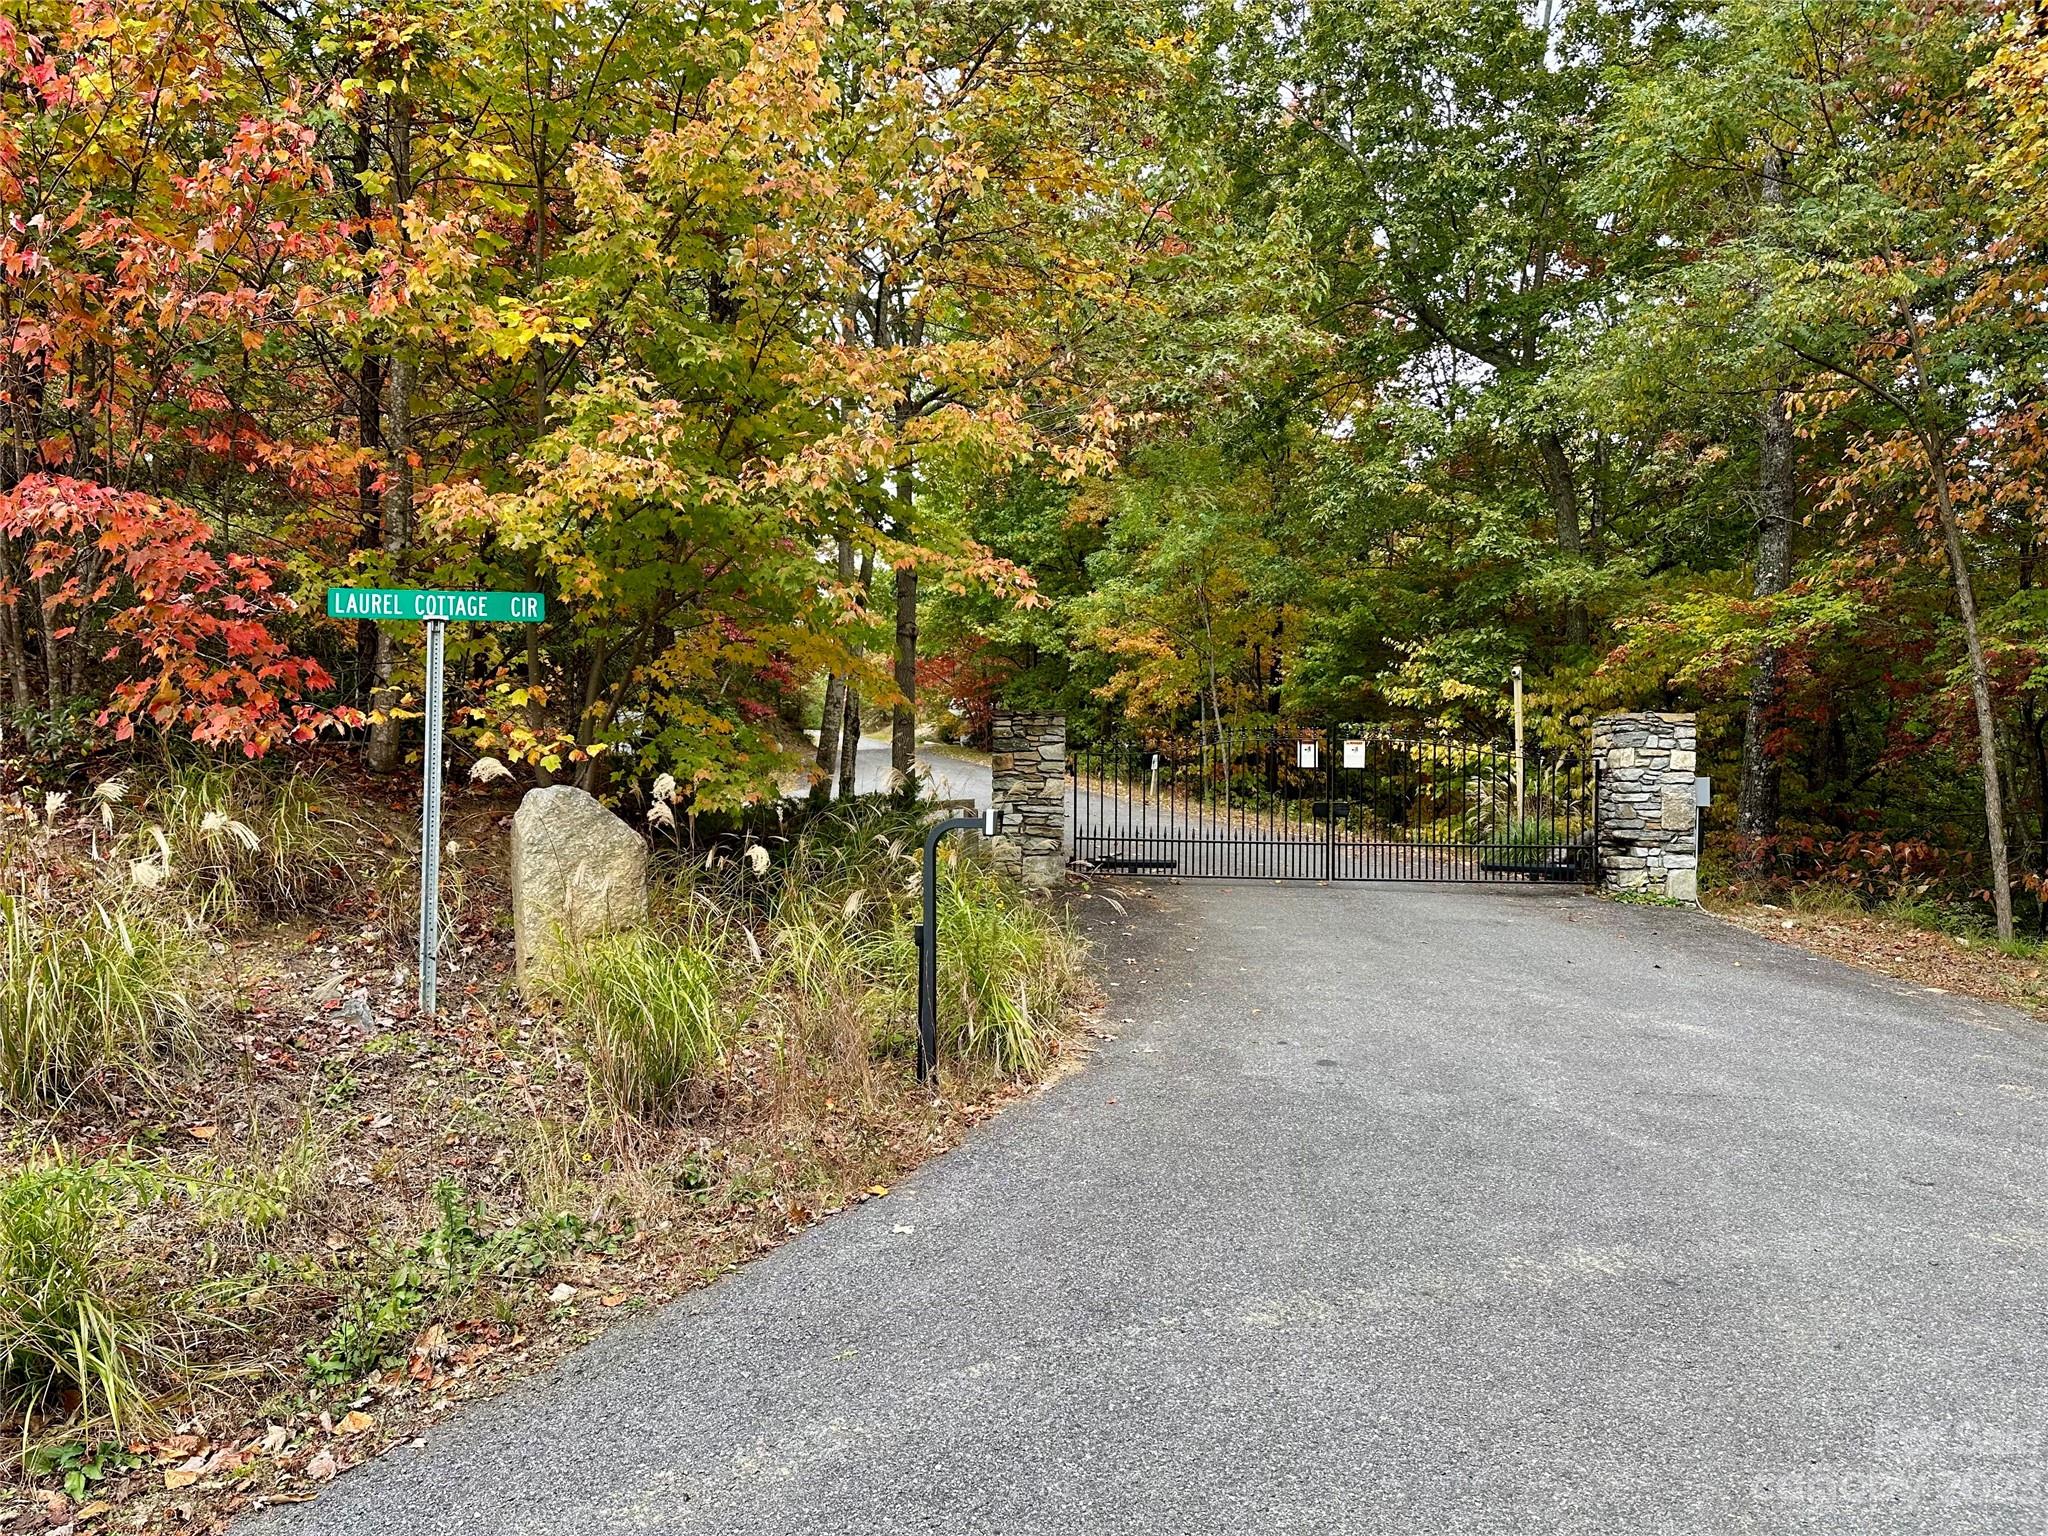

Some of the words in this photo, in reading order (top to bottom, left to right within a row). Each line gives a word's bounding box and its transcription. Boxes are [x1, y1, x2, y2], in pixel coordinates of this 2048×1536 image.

[335, 593, 403, 615] LAUREL
[415, 595, 488, 617] COTTAGE
[511, 597, 538, 618] CIR
